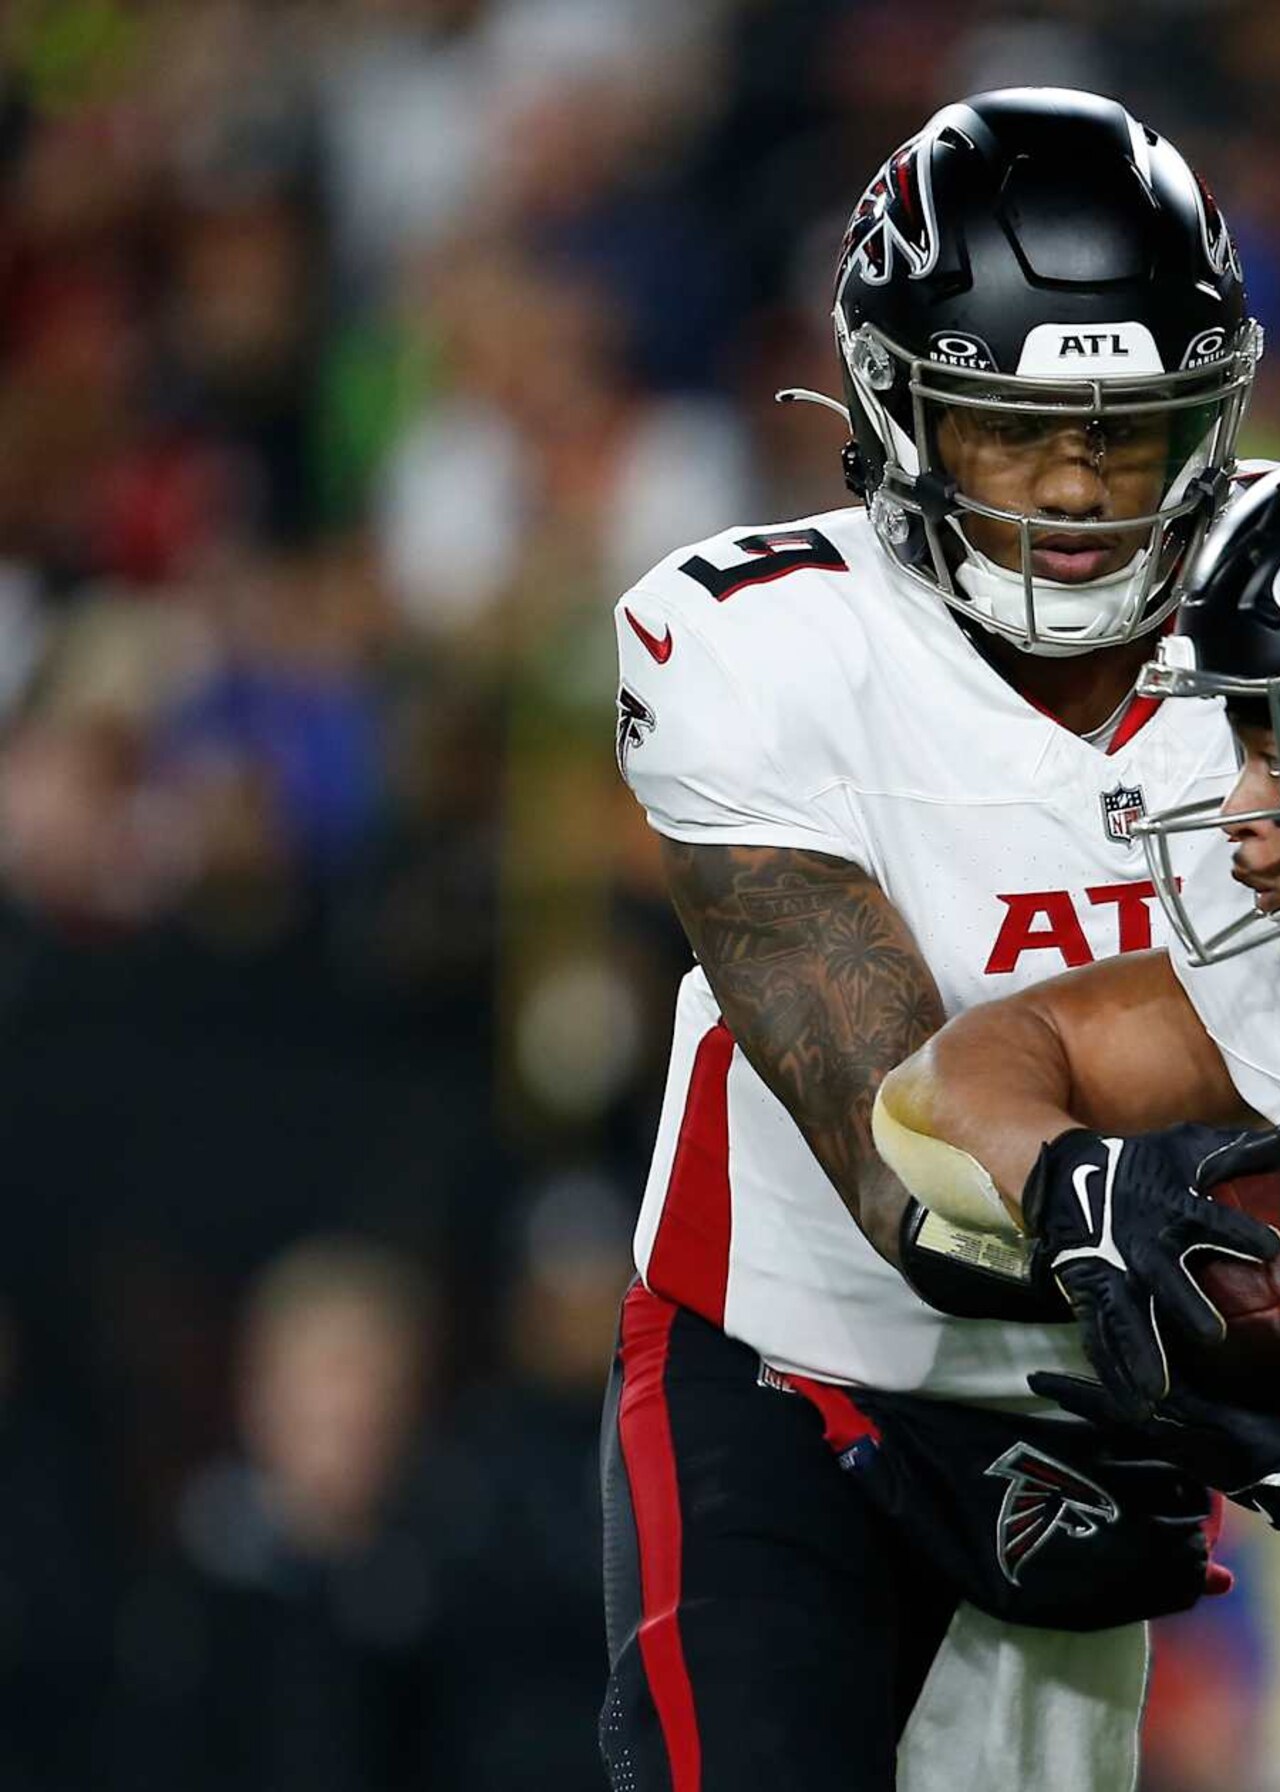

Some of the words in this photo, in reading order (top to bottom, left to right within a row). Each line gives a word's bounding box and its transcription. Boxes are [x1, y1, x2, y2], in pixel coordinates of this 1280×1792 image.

[929, 351, 988, 369] OAKLEY
[1059, 334, 1129, 355] ATL
[678, 527, 849, 602] 9
[984, 876, 1182, 975] AT
